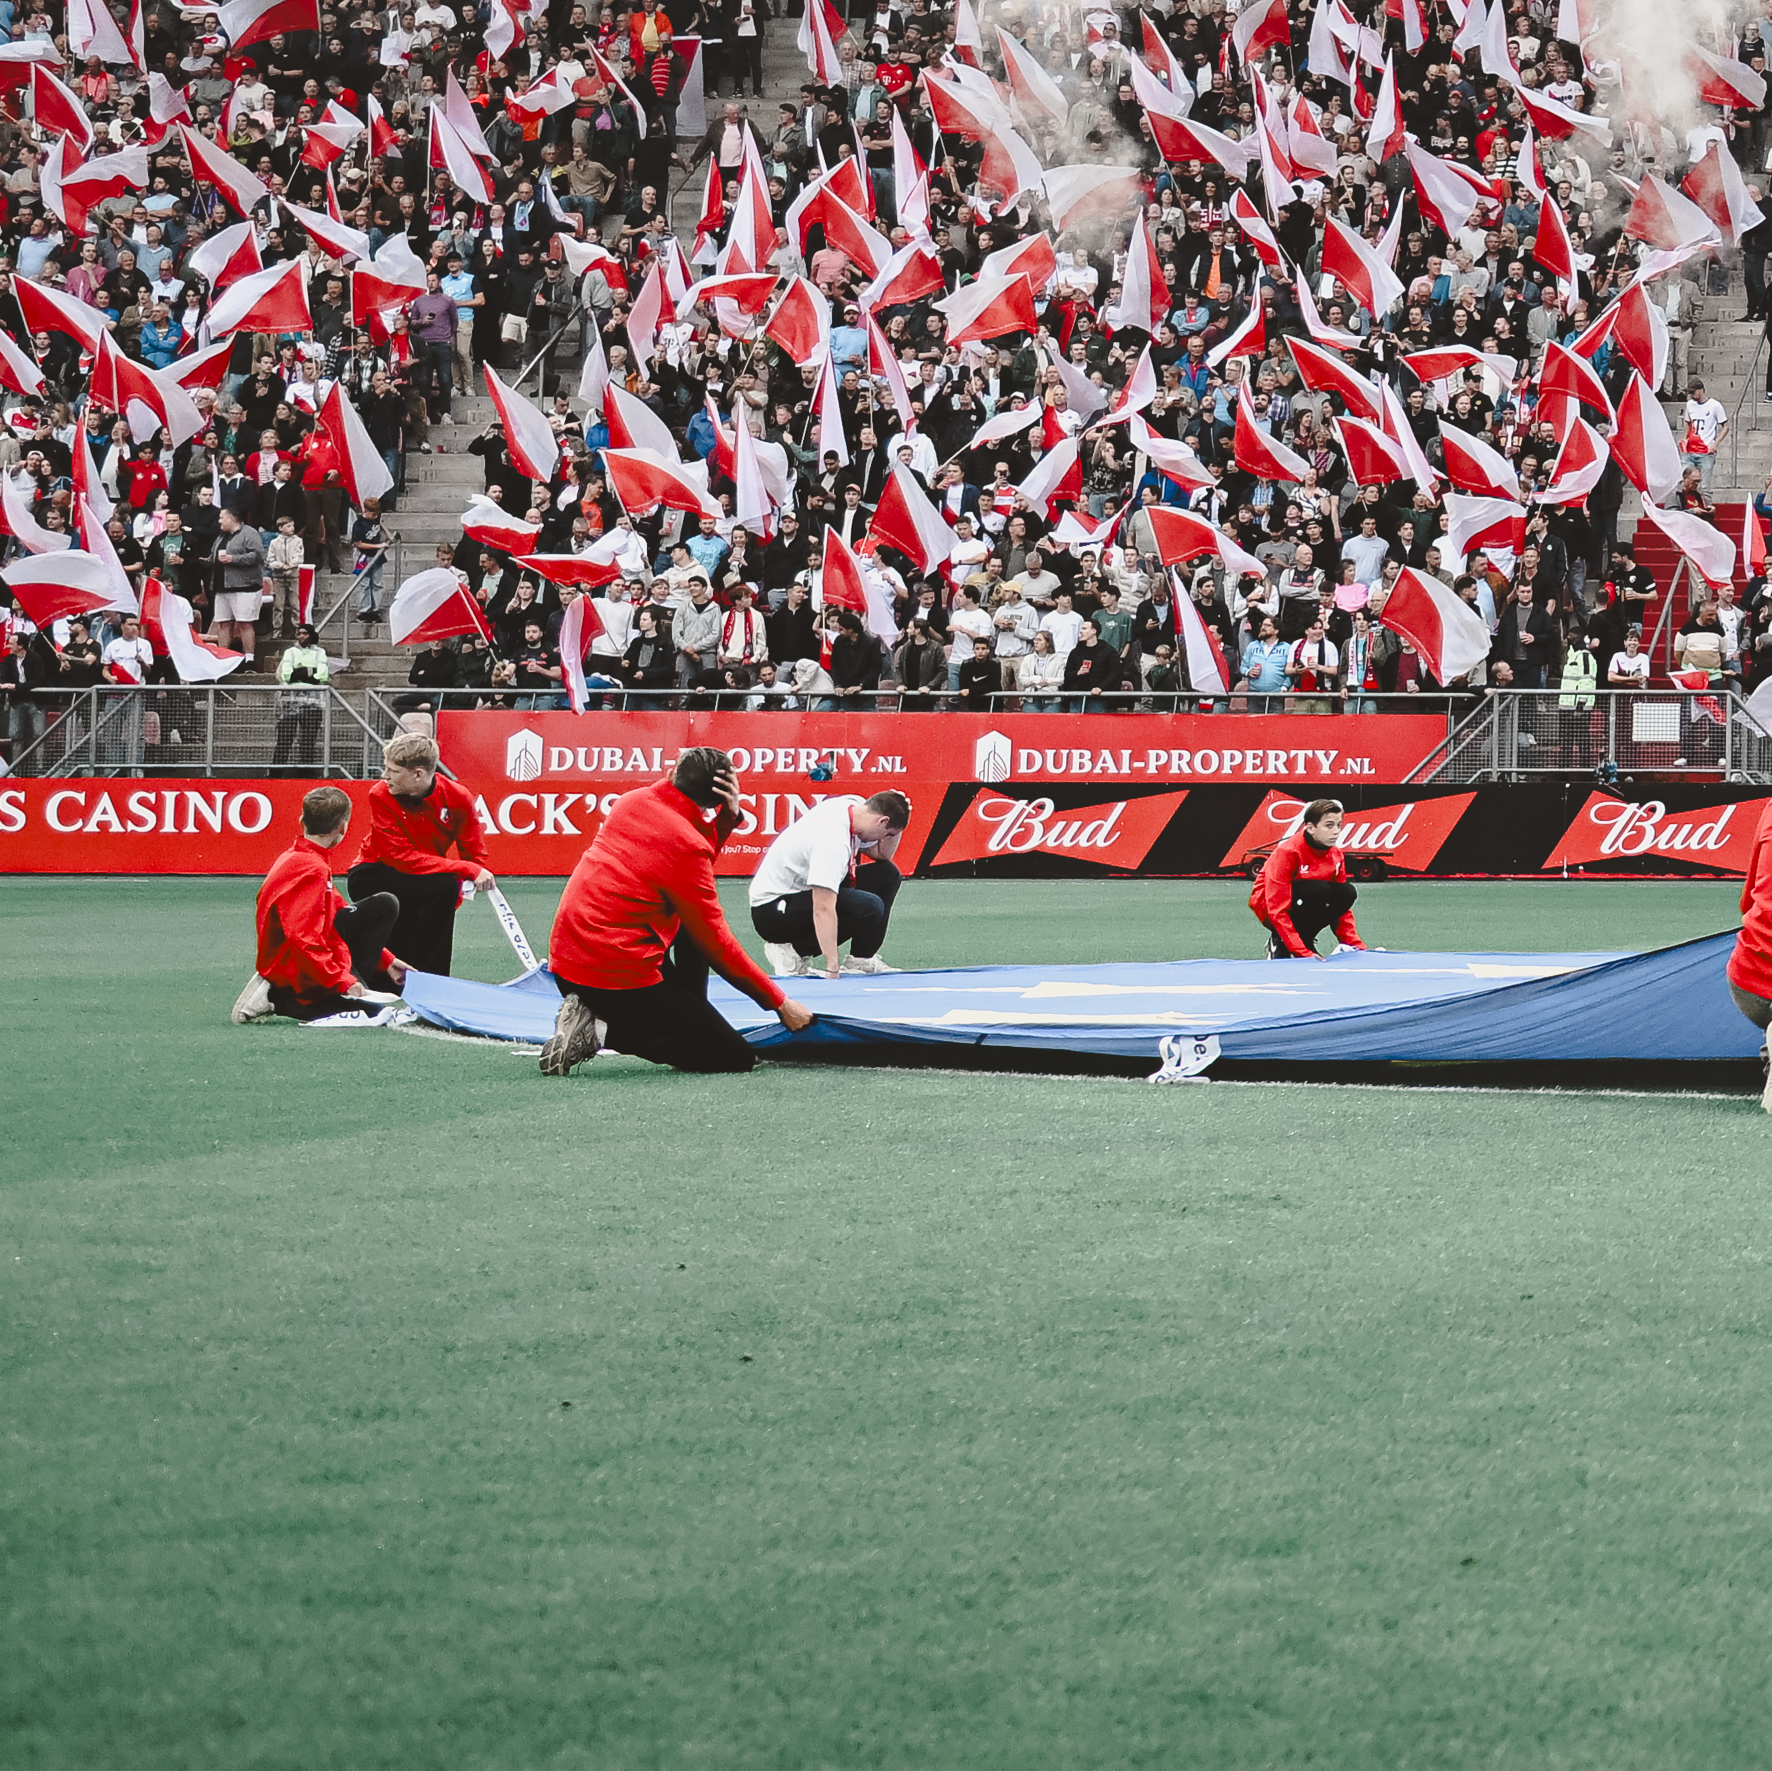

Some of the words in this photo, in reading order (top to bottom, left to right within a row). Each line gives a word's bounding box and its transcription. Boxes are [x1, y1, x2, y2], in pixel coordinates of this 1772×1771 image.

[549, 746, 907, 774] DUBAI-OPERTY.NL
[1017, 748, 1376, 776] DUBAI-PROPERTY.NL
[45, 790, 274, 834] CASINO
[977, 796, 1128, 852] Bud
[1588, 799, 1738, 855] Bud
